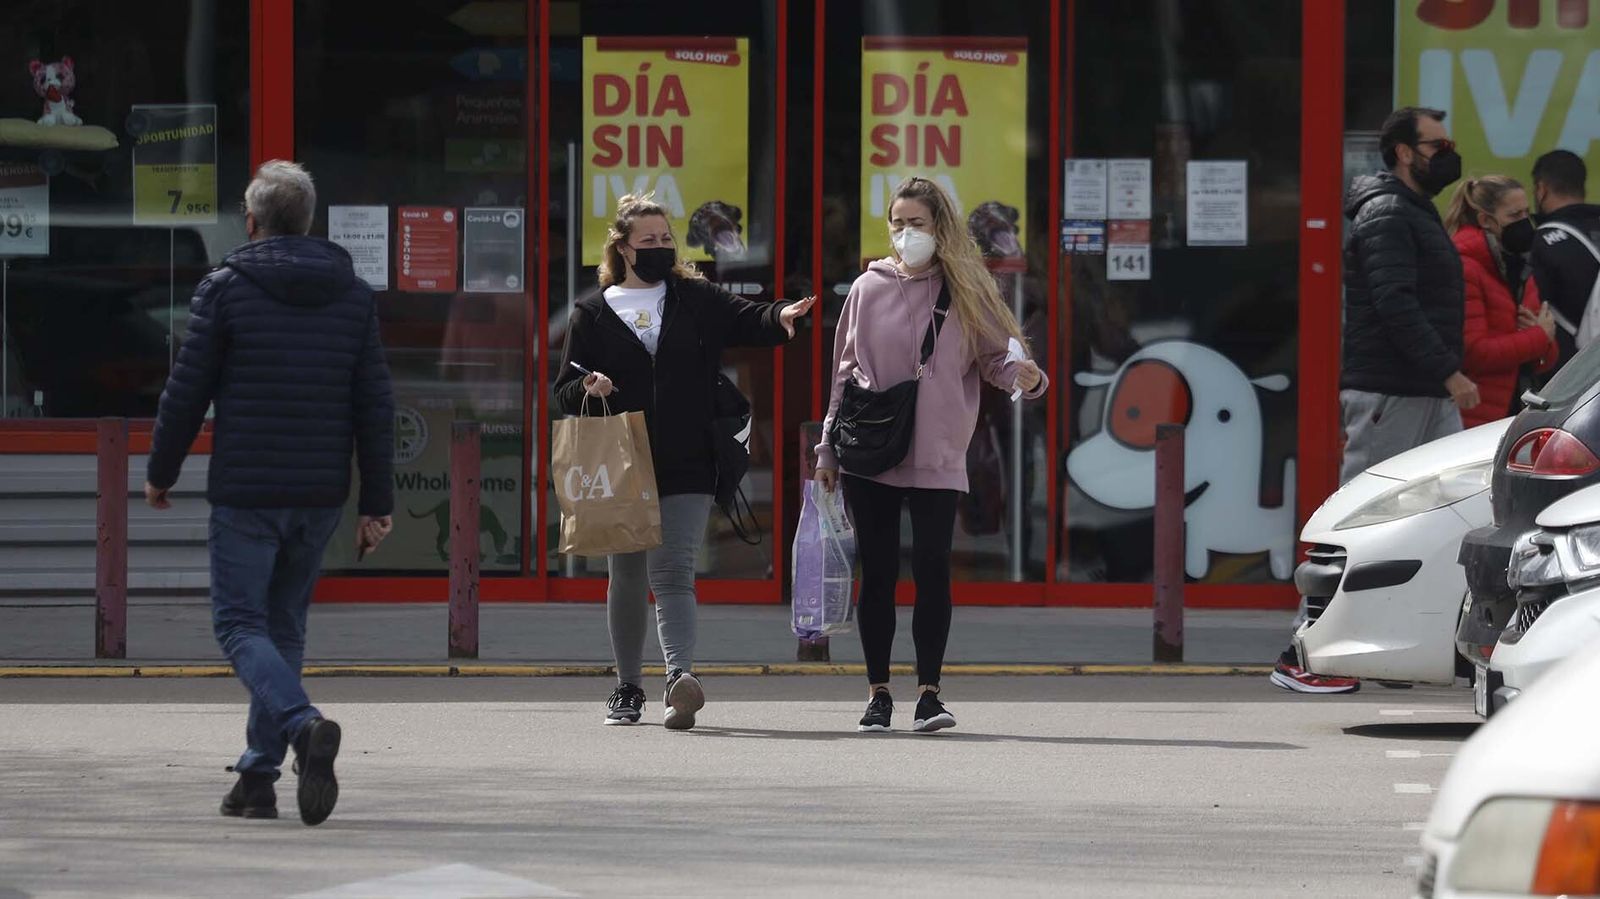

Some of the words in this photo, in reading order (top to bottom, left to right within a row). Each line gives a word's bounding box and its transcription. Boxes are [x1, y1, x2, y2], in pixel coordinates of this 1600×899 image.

[706, 53, 729, 64] HOY
[985, 53, 1008, 64] HOY
[593, 63, 690, 117] DÍA
[871, 62, 969, 117] DÍA
[592, 124, 684, 168] SIN
[869, 124, 961, 167] SIN
[402, 211, 428, 219] Covid-19
[467, 213, 500, 223] Covid-19
[1112, 255, 1146, 272] 141
[564, 464, 615, 502] C&A
